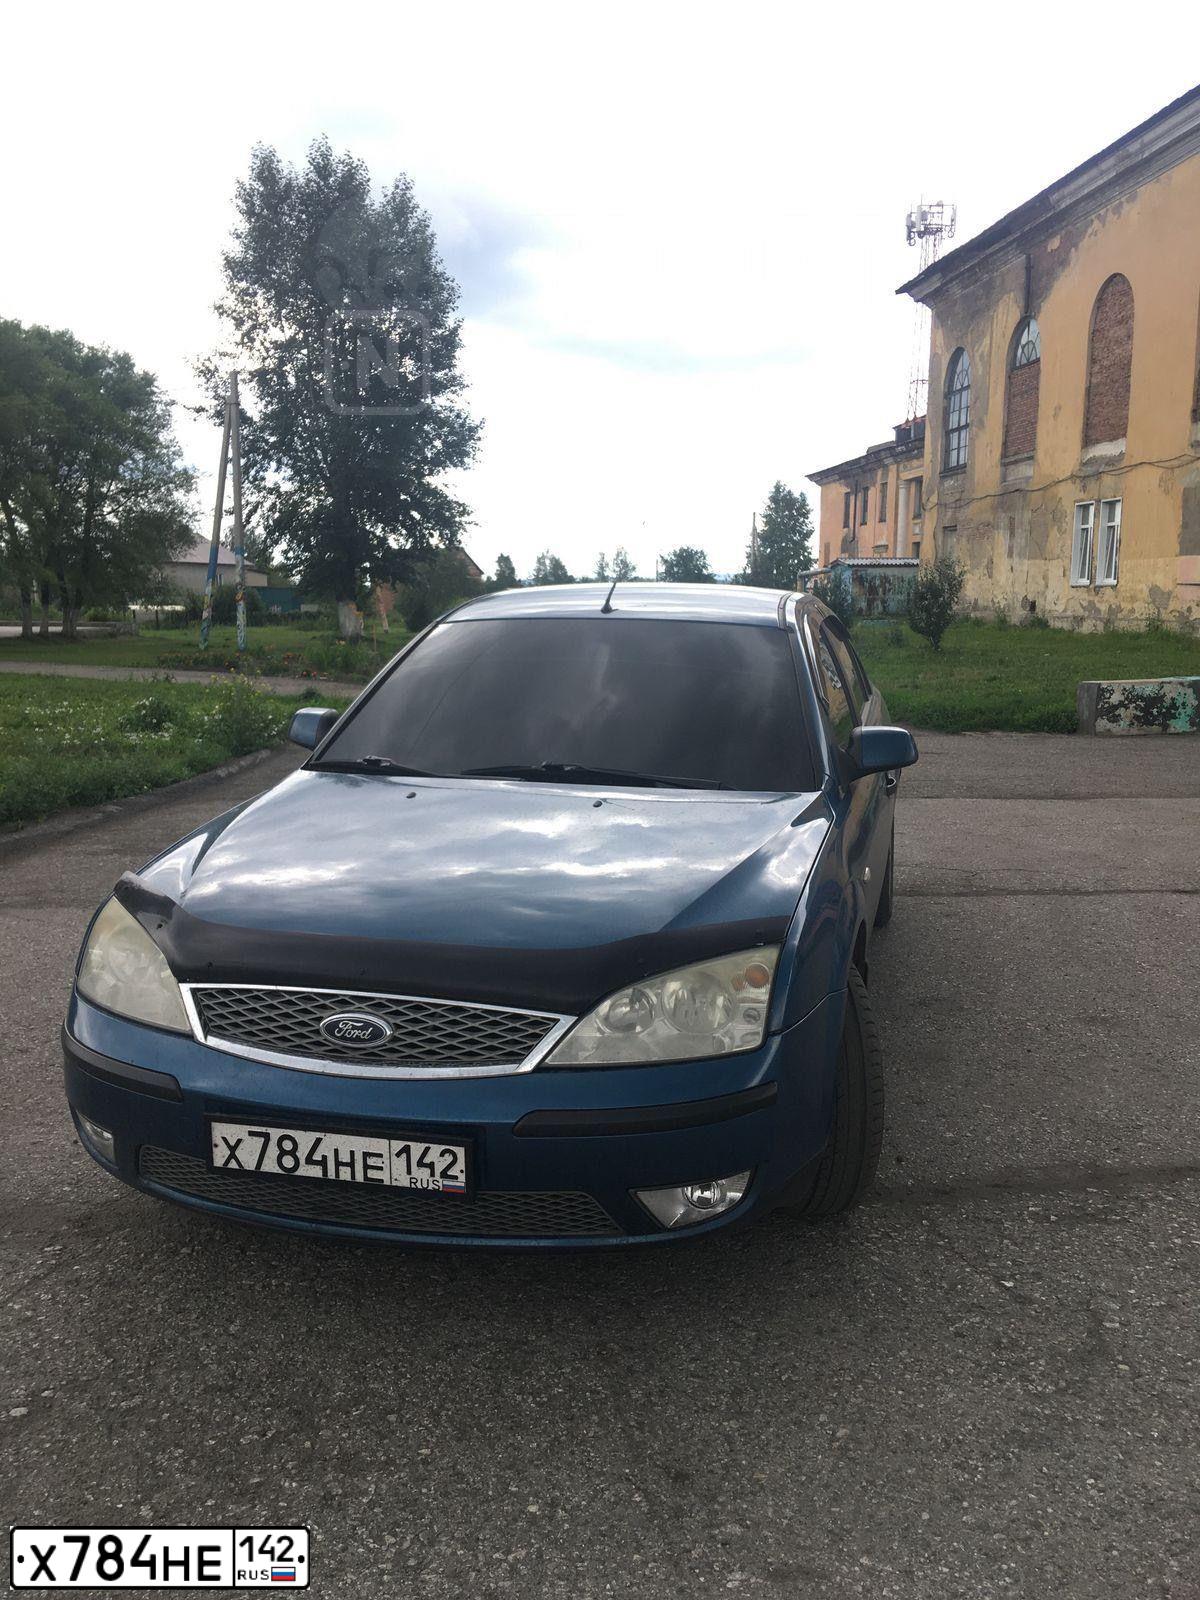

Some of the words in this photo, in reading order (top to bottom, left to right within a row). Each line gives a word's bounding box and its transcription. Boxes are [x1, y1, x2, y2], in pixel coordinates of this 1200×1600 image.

[335, 1021, 373, 1039] Ford
[395, 1144, 459, 1180] 142
[409, 1177, 440, 1191] RUS
